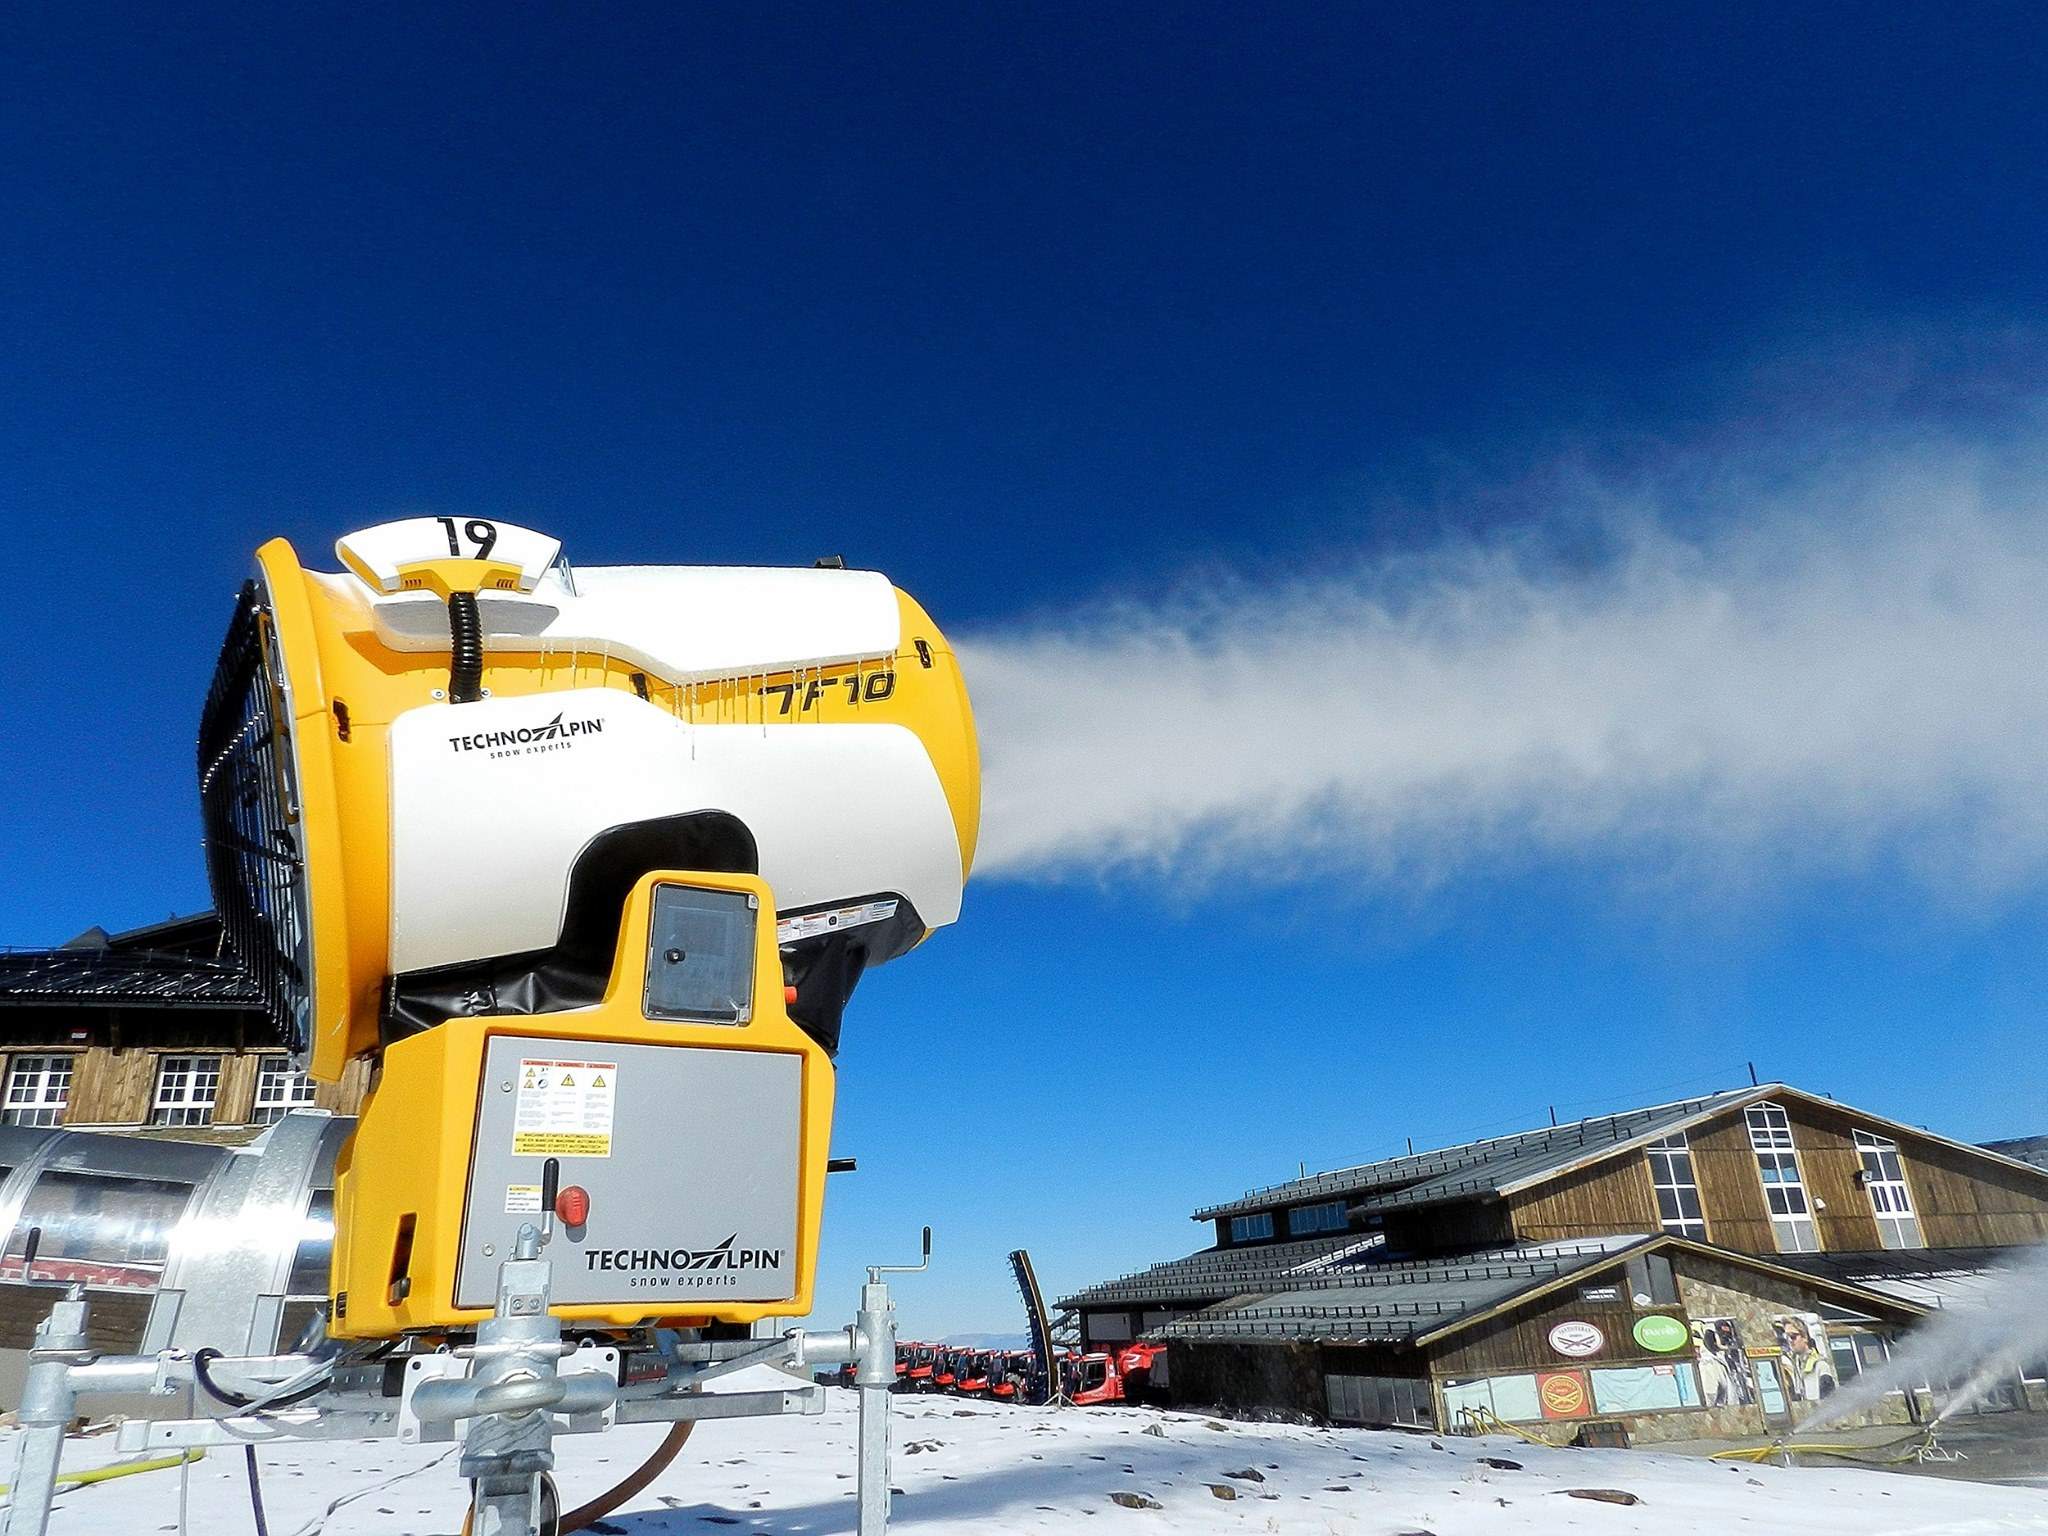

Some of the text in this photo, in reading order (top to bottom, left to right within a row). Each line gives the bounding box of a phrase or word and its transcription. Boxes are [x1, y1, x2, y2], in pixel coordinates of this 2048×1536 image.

[437, 517, 497, 560] 19
[490, 742, 572, 759] snow experts
[630, 1275, 737, 1288] snow experts
